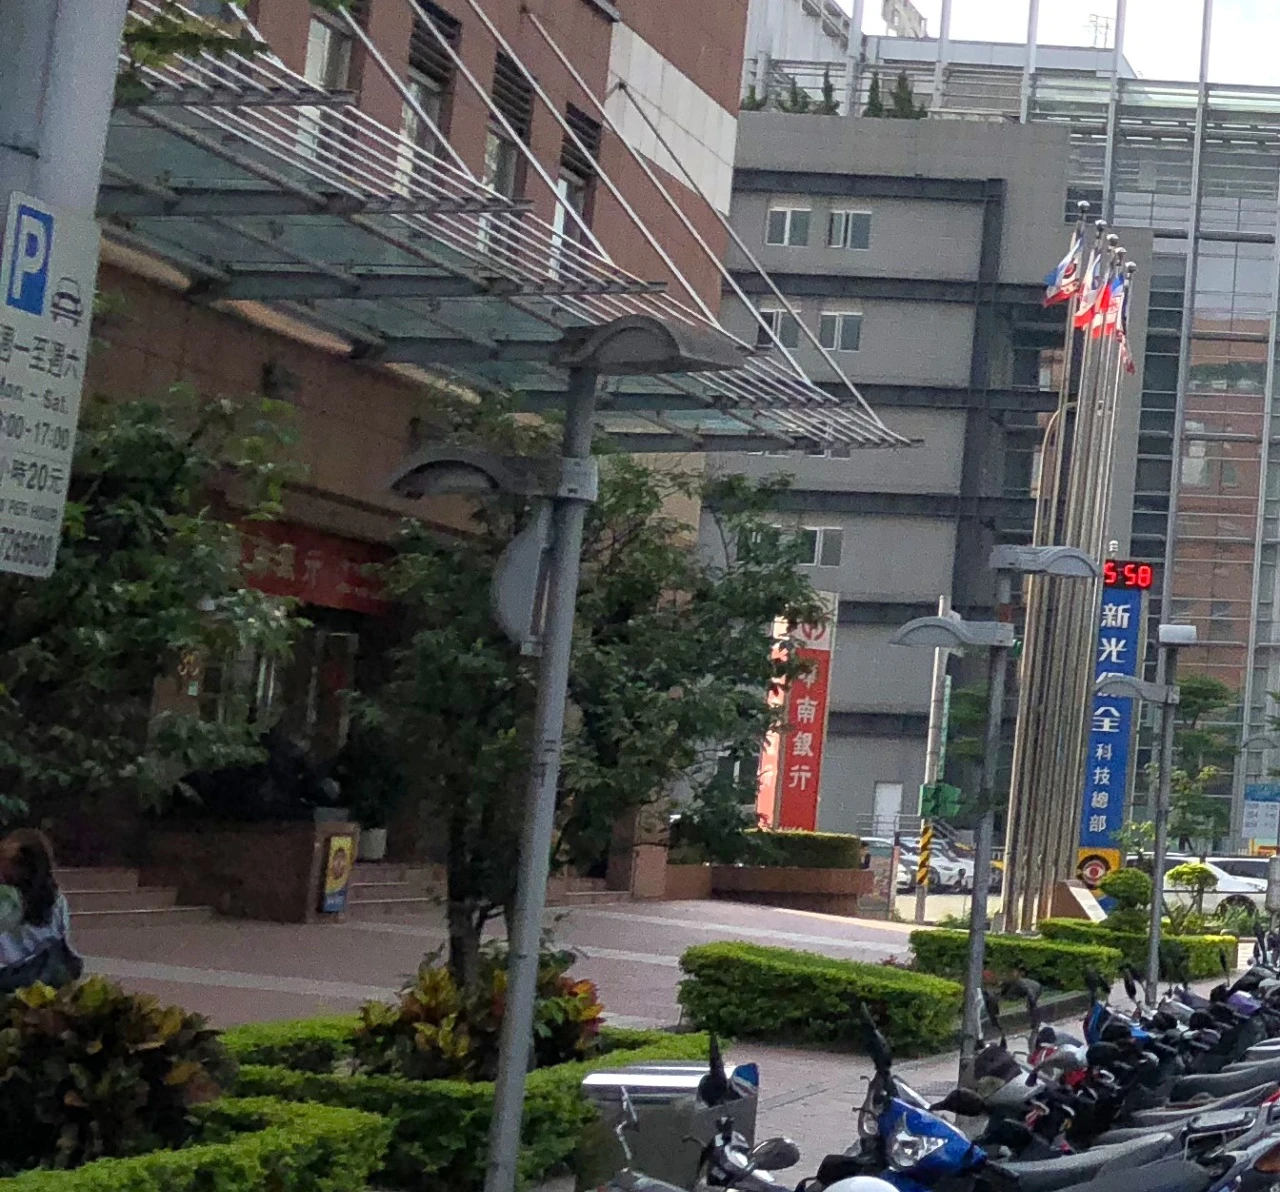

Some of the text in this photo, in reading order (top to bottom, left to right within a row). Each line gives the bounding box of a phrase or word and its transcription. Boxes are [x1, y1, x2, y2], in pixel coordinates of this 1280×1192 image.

[12, 214, 46, 300] P
[1089, 742, 1113, 833] 科技總部
